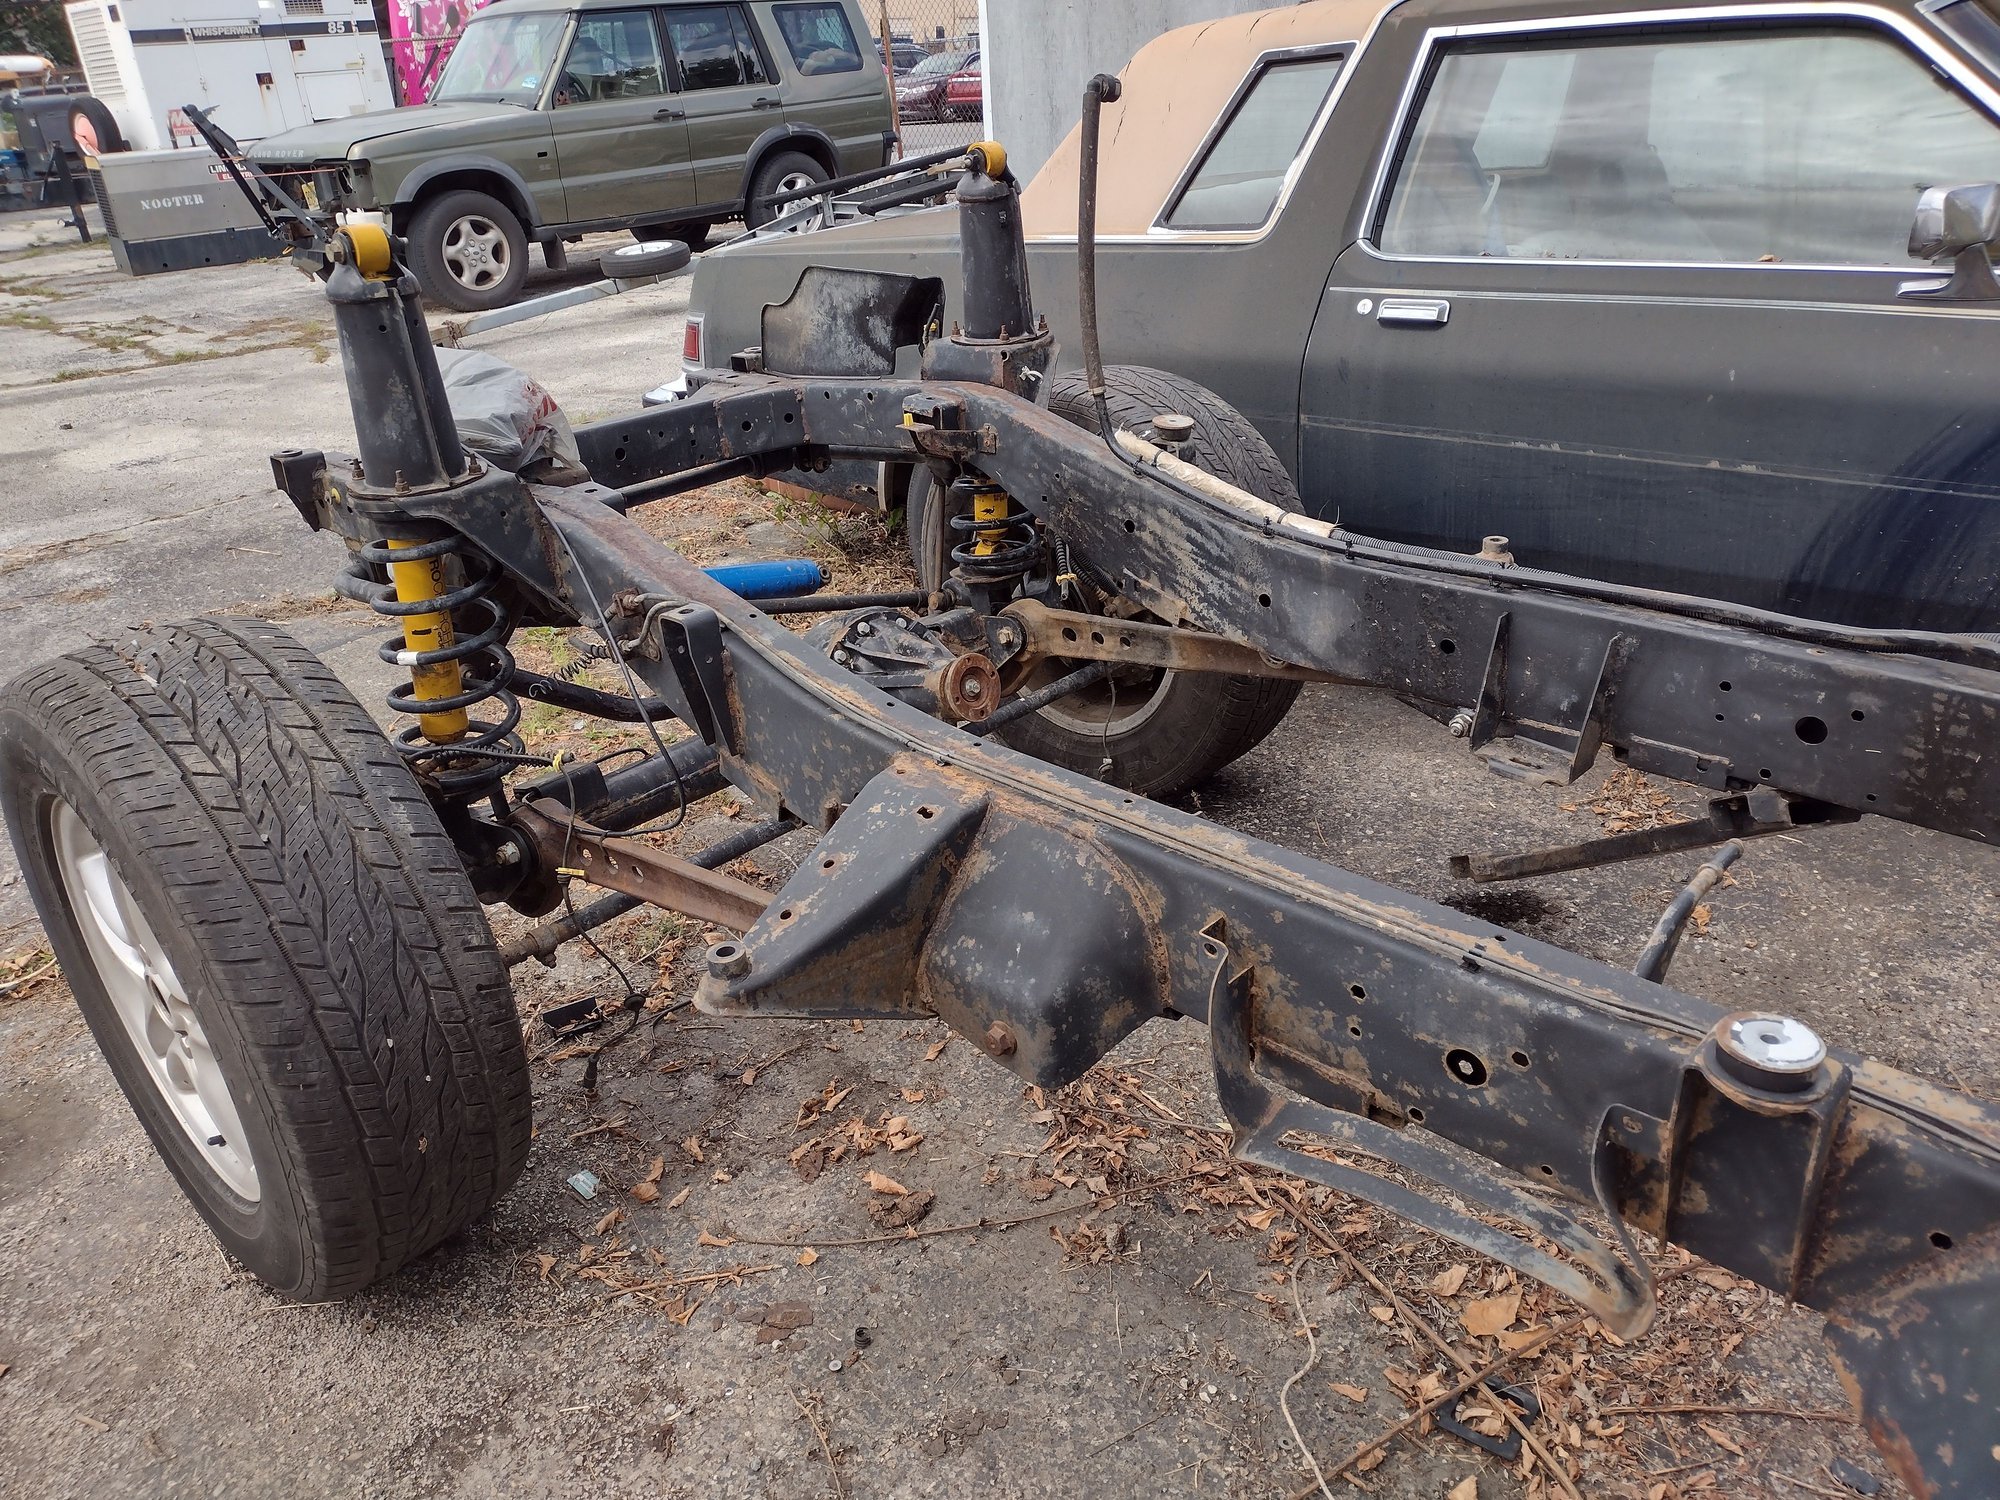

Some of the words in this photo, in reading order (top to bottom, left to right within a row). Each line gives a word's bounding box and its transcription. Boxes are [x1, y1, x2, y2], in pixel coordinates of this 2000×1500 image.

[193, 25, 261, 37] WHISPERWATT
[328, 21, 345, 34] 85
[275, 150, 304, 158] ROVER
